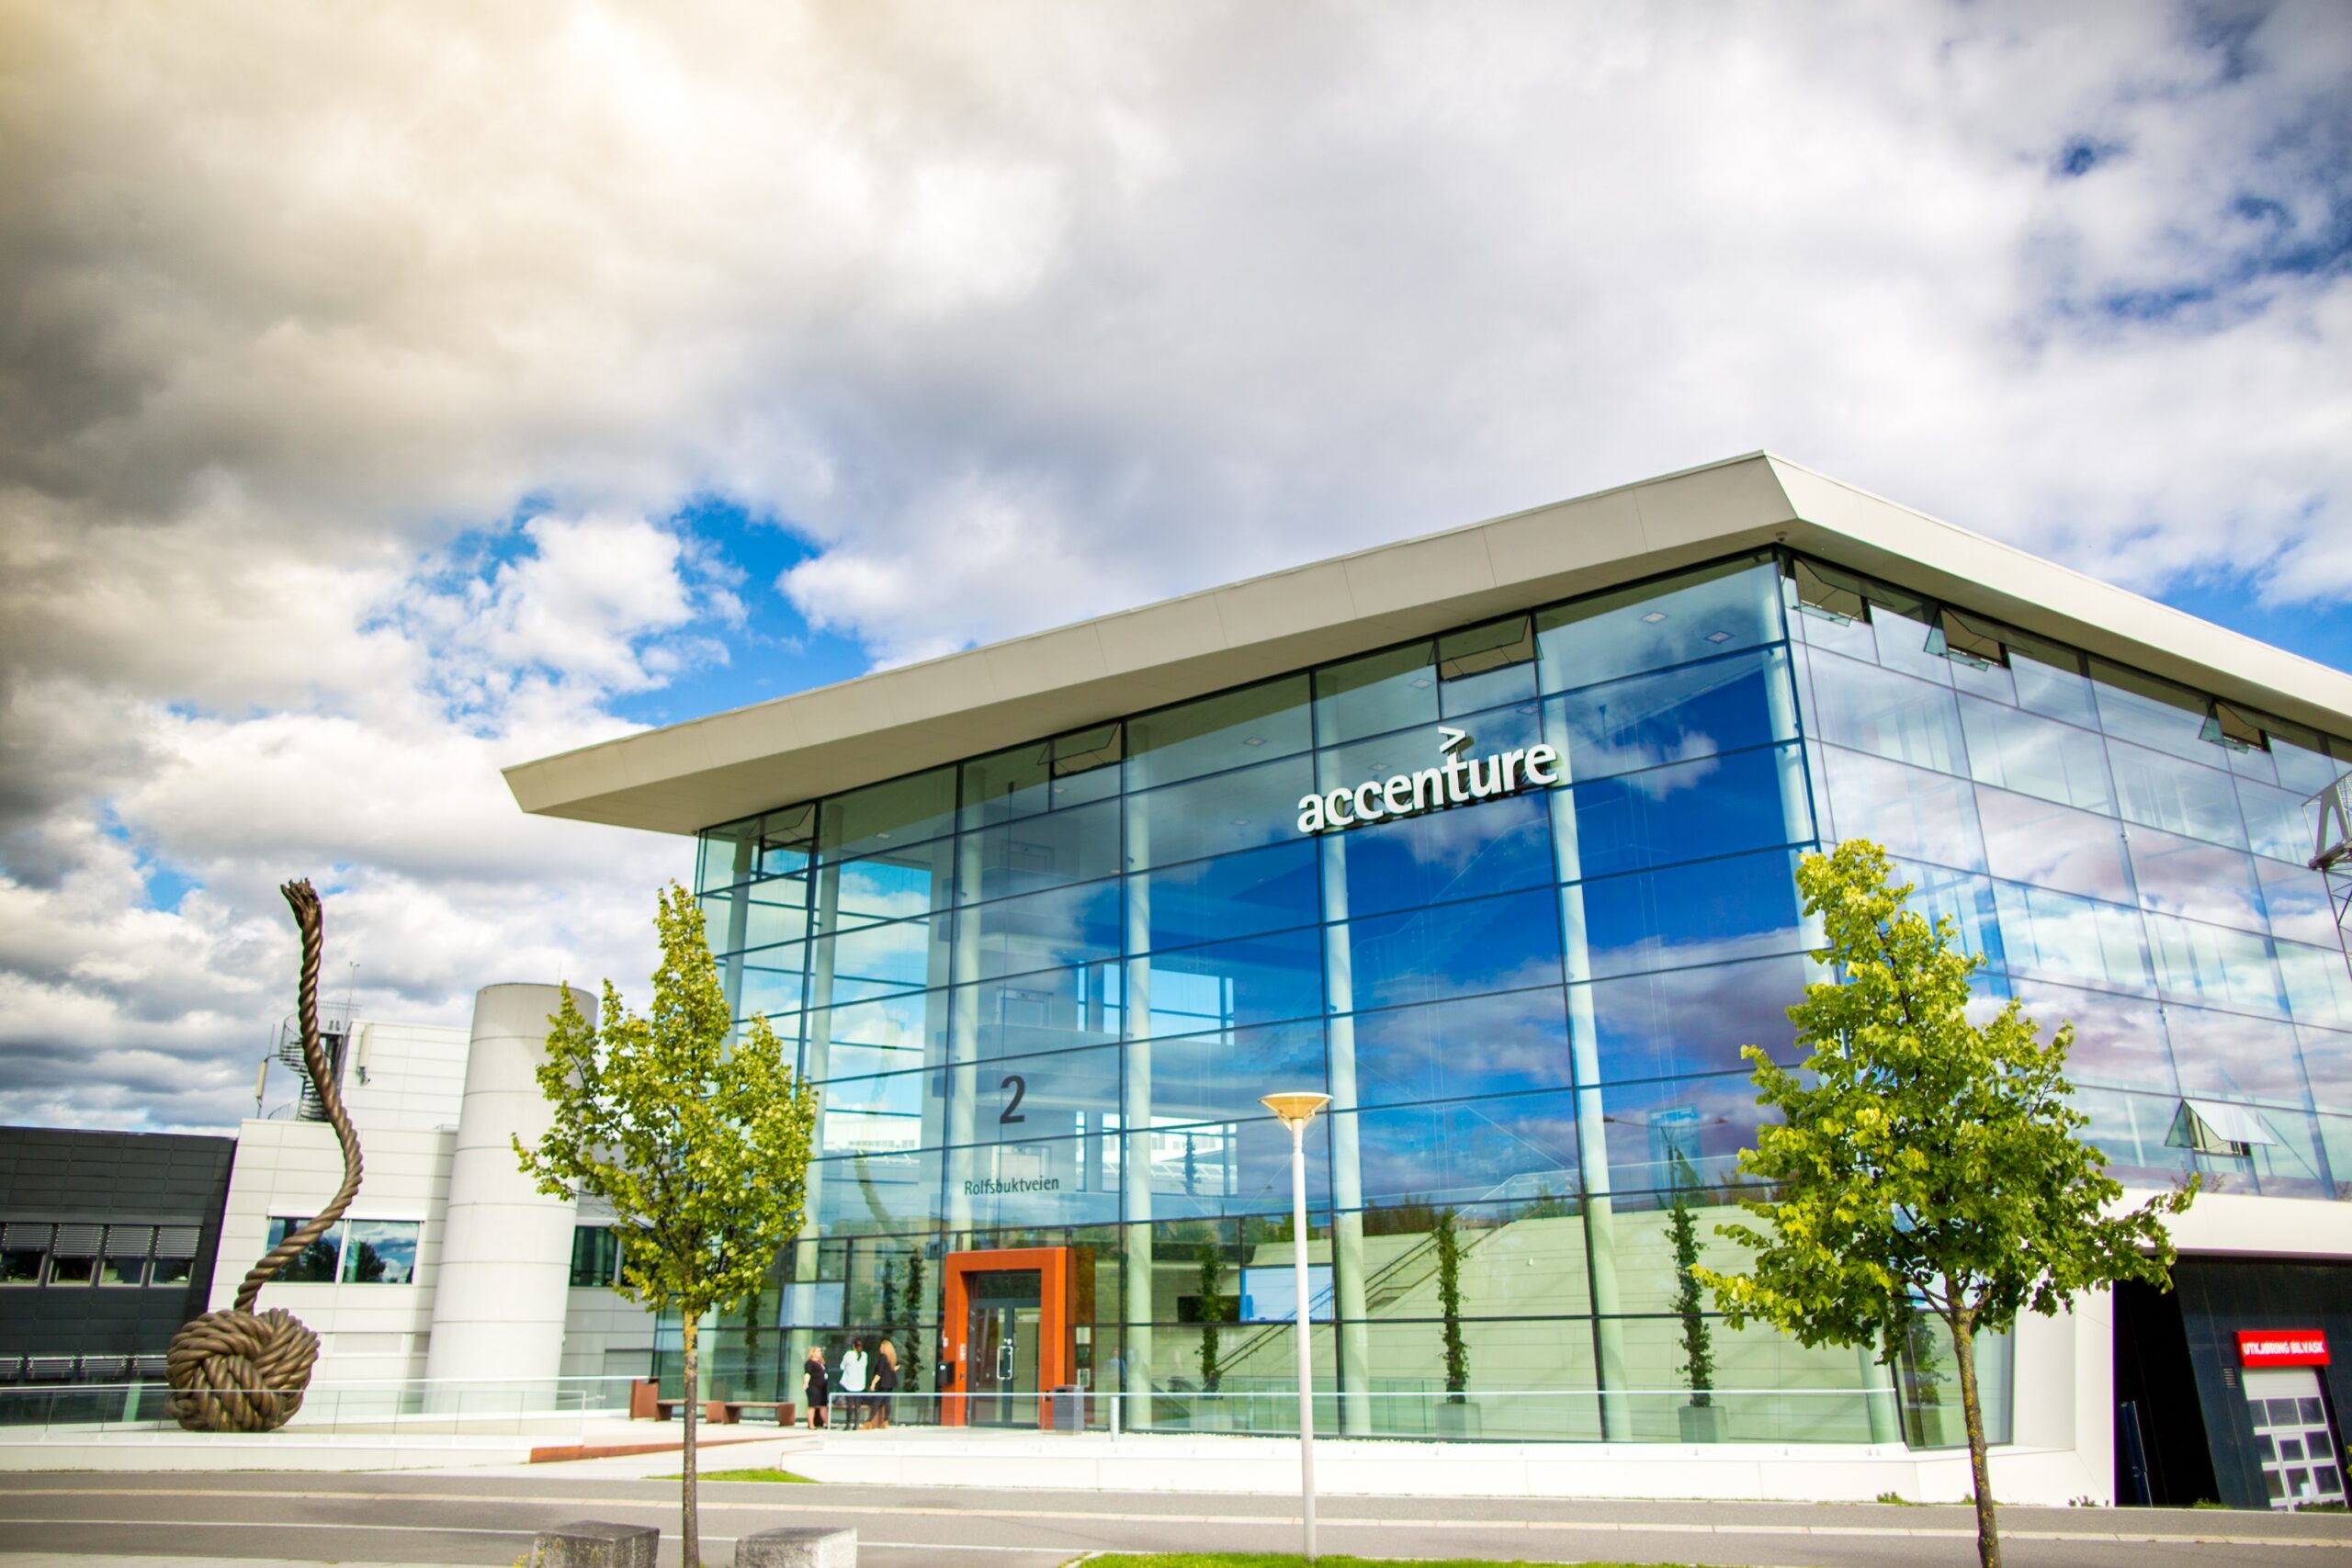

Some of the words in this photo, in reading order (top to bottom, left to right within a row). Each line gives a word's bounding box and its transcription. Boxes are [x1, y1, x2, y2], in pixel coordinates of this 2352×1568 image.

[1296, 743, 1559, 833] accenture
[999, 1074, 1026, 1125] 2
[964, 1175, 1059, 1196] Rolfsbuktveien
[2290, 1340, 2325, 1354] BILVASK
